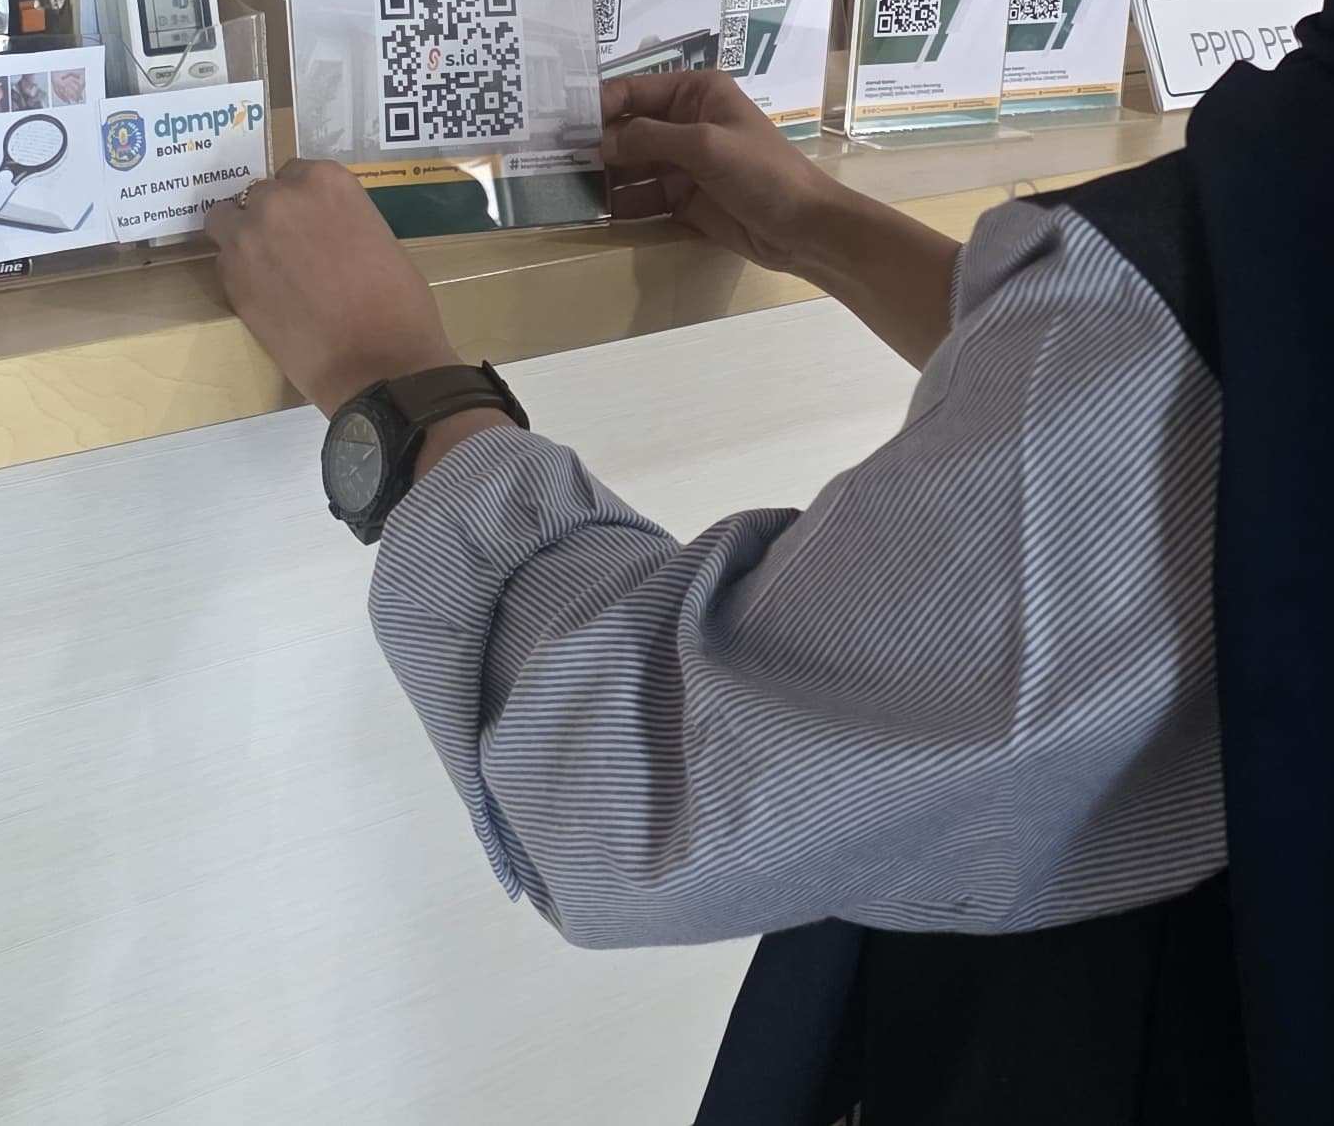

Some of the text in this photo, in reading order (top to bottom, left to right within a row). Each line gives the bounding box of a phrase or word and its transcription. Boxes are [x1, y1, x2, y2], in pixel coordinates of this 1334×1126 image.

[445, 49, 477, 66] s.id
[1191, 25, 1296, 66] PPID PE
[120, 165, 251, 200] ALAT BANTU MEMBACA
[117, 204, 199, 228] Kaca Pembesar
